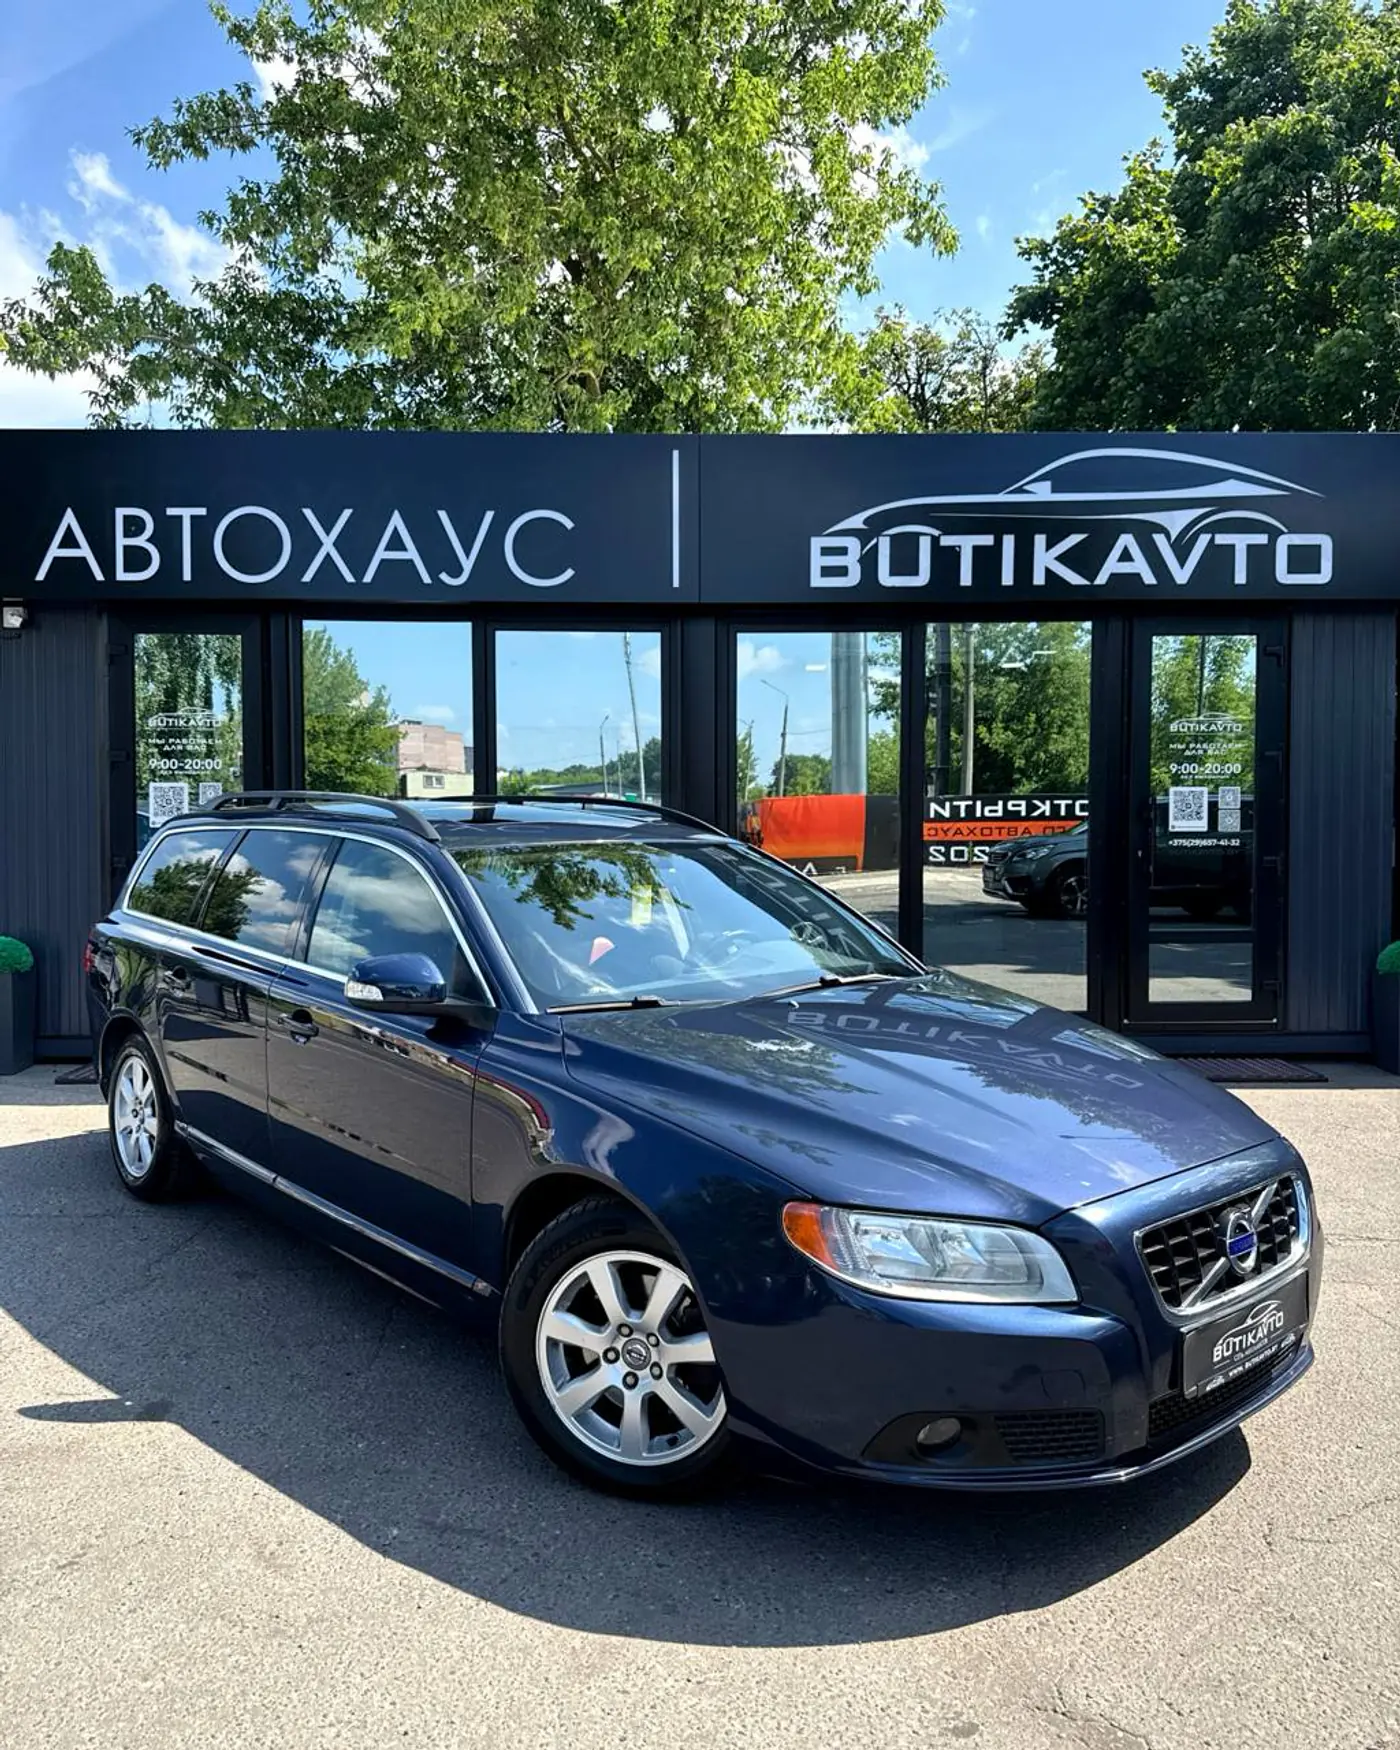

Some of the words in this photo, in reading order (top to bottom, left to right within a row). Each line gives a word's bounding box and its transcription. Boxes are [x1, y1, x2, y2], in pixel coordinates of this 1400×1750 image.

[35, 505, 576, 587] АВТОХАУС
[809, 532, 1333, 587] BUTIKAVTO
[1169, 722, 1242, 732] BUTIKAVTO
[149, 758, 222, 770] 9:00-20:00
[1169, 763, 1242, 774] 9:00-20:00
[1212, 1311, 1284, 1363] BUTIKAVTO
